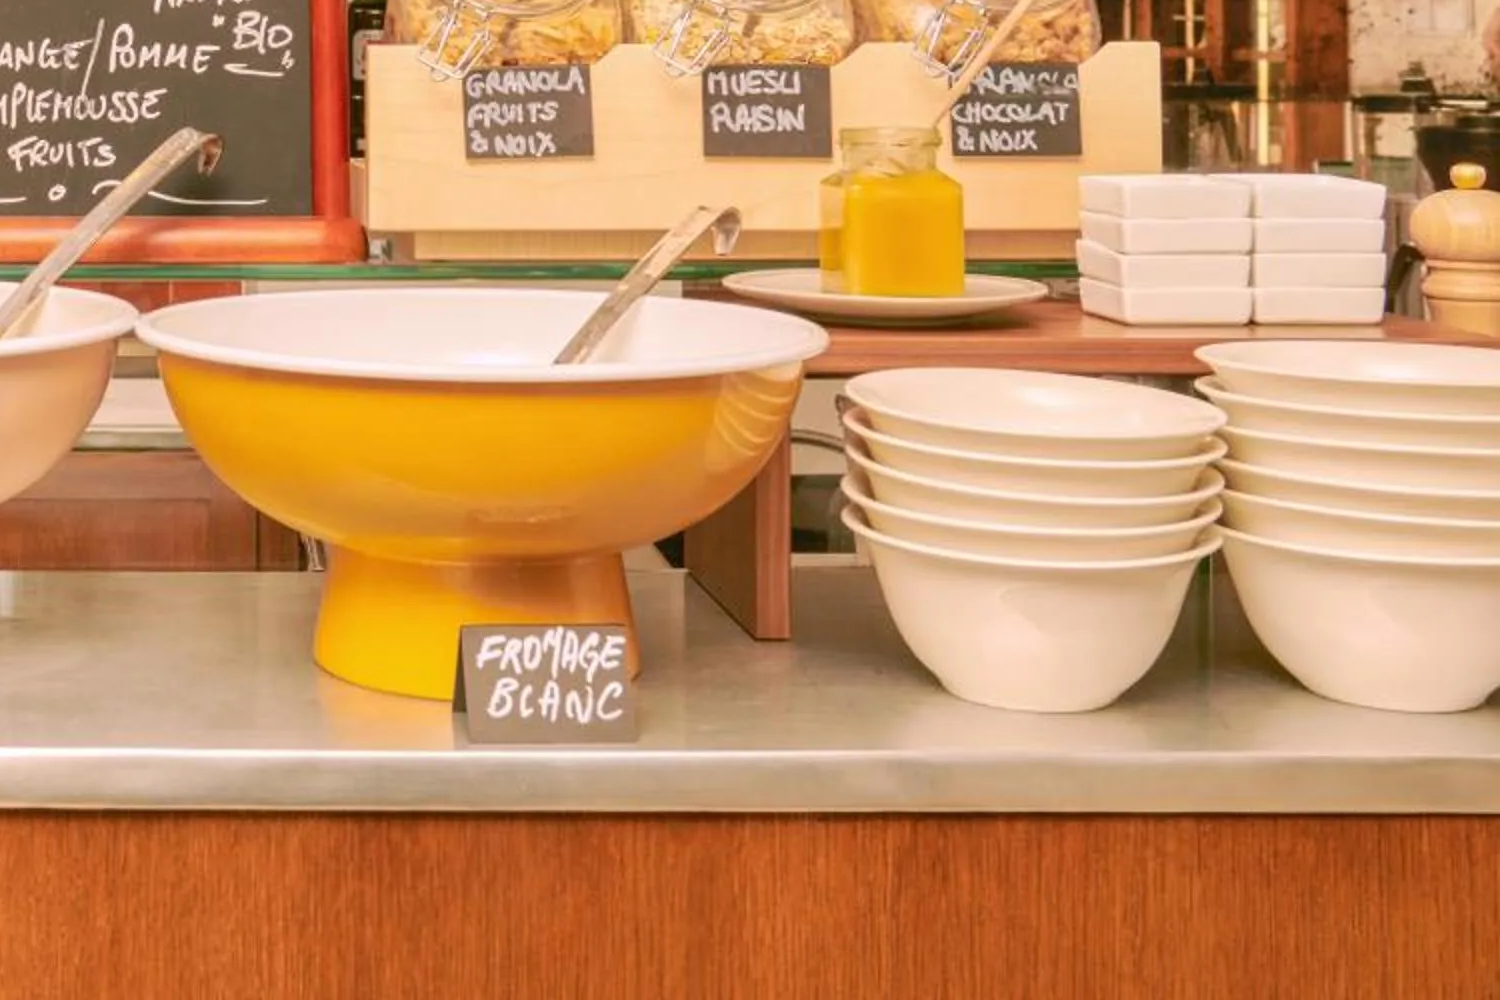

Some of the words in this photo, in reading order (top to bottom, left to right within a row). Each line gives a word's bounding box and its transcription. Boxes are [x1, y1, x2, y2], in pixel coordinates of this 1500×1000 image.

[465, 65, 586, 99] GRANOLA
[707, 68, 802, 97] MUESLI
[964, 65, 1079, 96] RANOLA
[467, 100, 560, 130] FRUITS
[709, 101, 806, 135] RAISIN
[951, 100, 1070, 126] CHOCOLAT
[470, 129, 489, 154] &
[493, 130, 557, 158] NOIX
[956, 125, 975, 152] &
[979, 128, 1038, 153] NOIX
[8, 140, 117, 172] FRUITS
[476, 625, 627, 680] FROMAGE
[486, 677, 624, 724] BLANC
